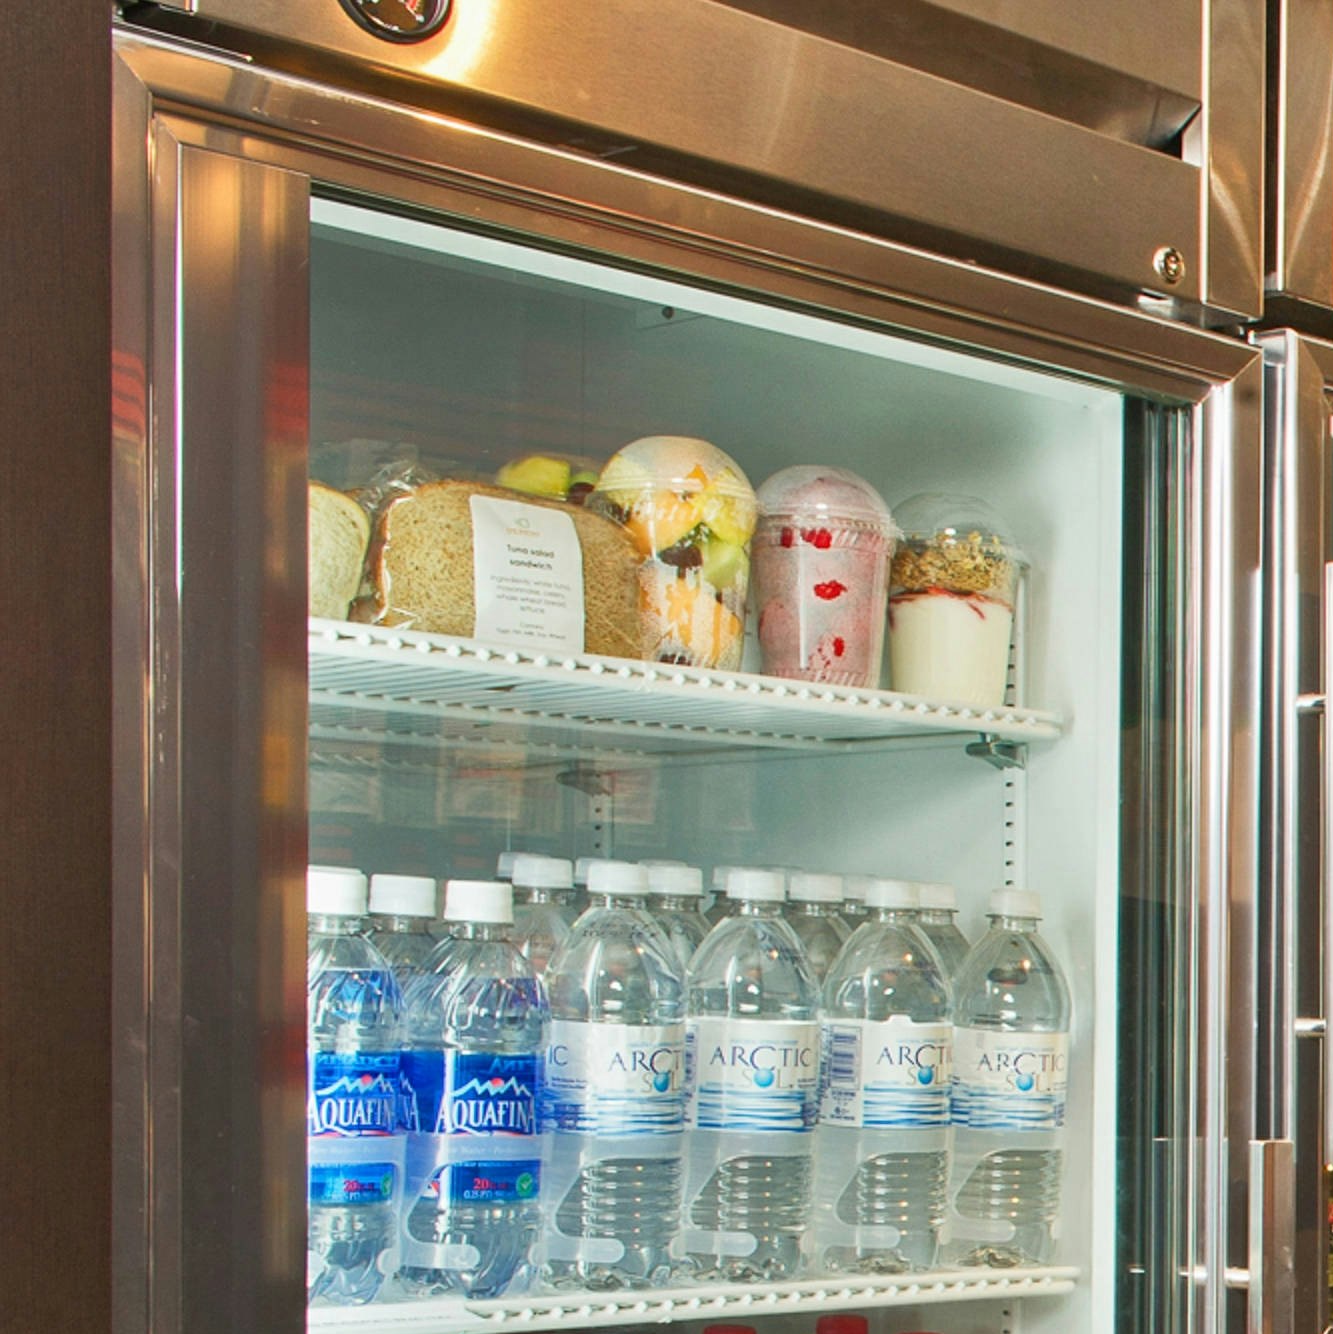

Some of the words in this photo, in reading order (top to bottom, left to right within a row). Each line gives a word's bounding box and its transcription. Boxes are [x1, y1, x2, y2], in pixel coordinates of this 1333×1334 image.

[507, 544, 529, 555] Tuna
[531, 548, 555, 559] salad
[509, 560, 553, 571] sandwich
[709, 1045, 812, 1072] ARCTIC
[976, 1051, 1065, 1076] ARCTIC
[308, 1098, 396, 1137] AQUAFIN
[434, 1096, 538, 1137] AQUAFINA
[473, 1178, 490, 1190] 20
